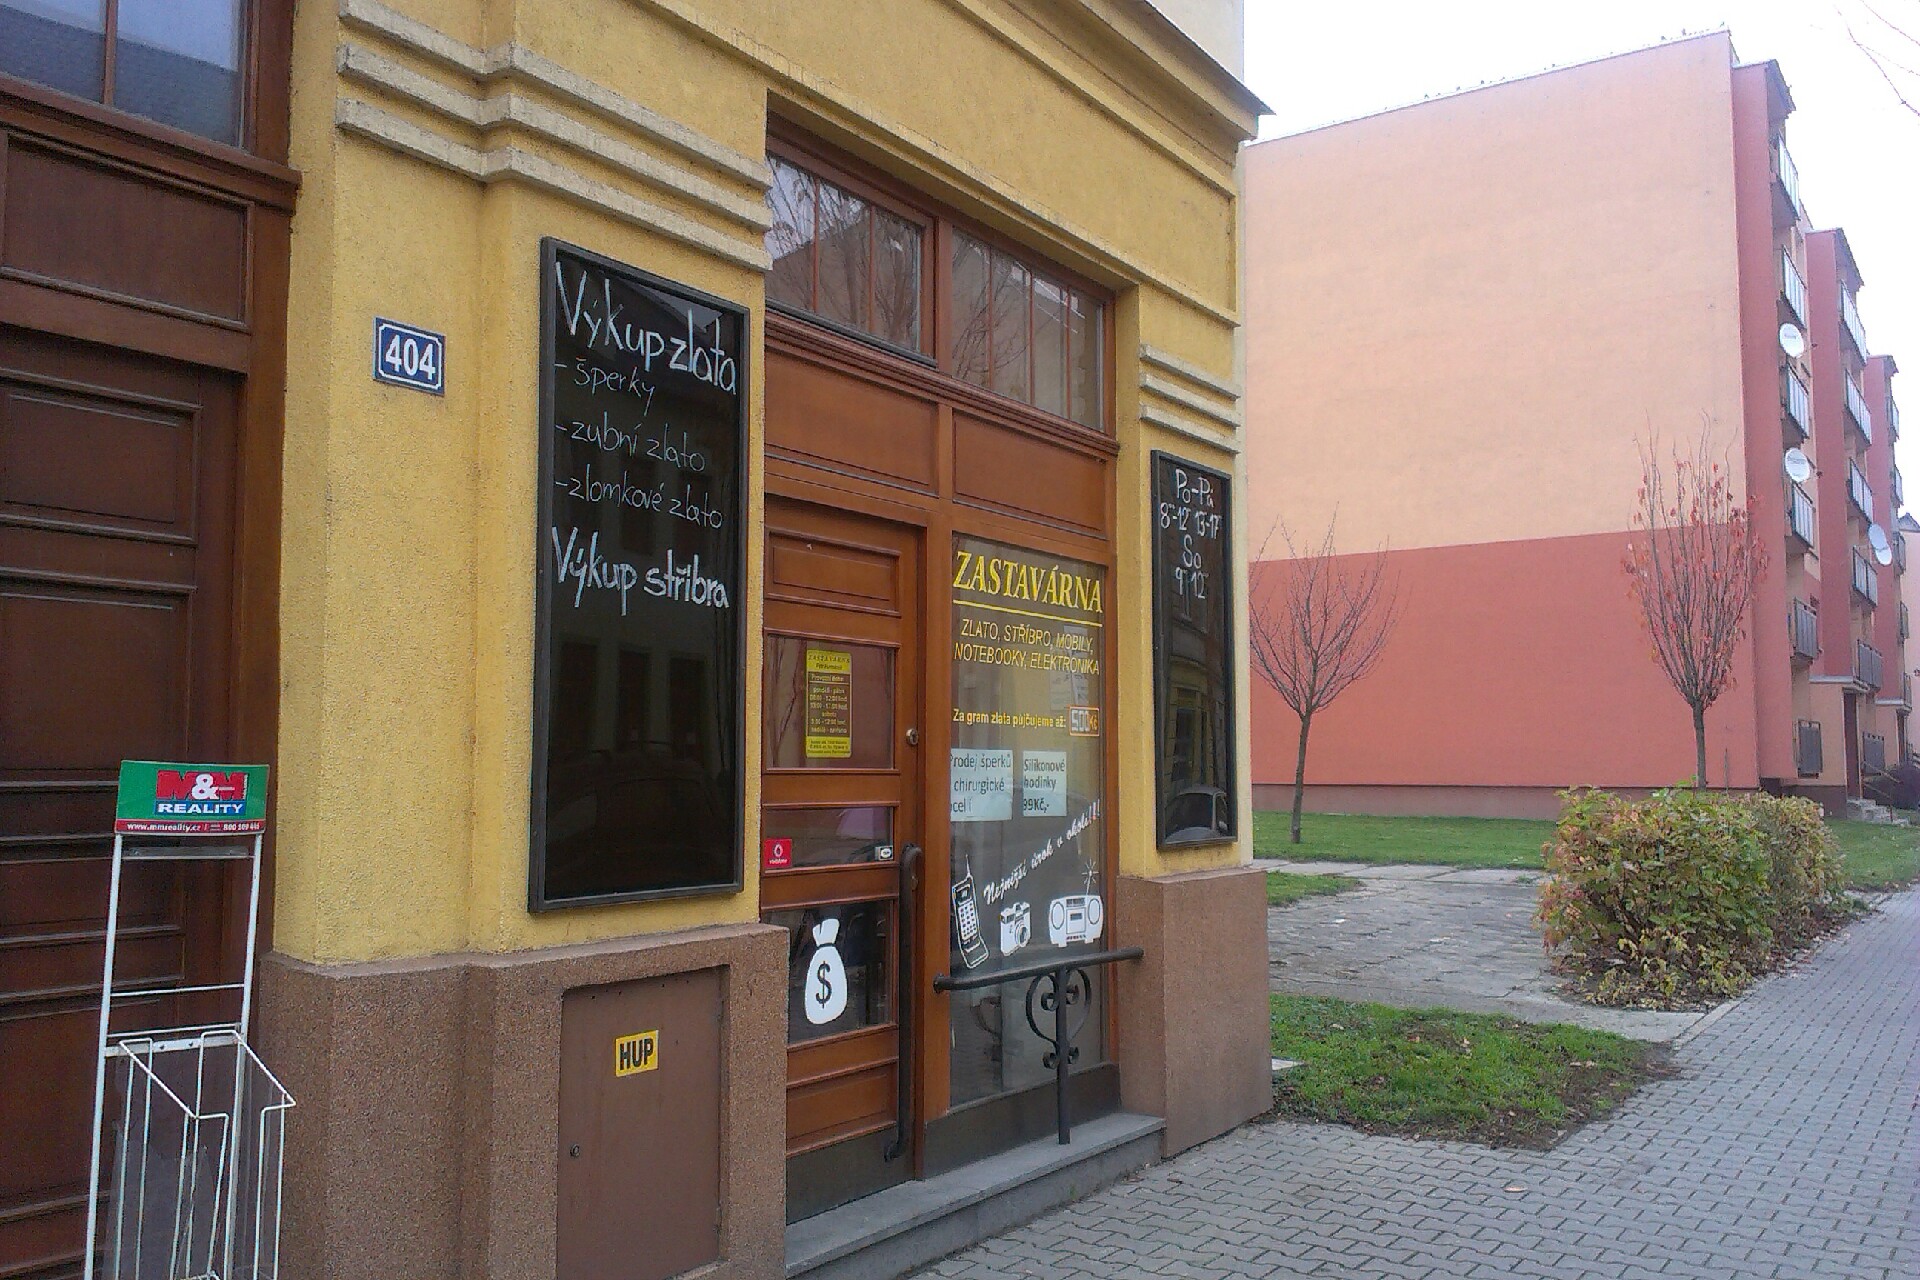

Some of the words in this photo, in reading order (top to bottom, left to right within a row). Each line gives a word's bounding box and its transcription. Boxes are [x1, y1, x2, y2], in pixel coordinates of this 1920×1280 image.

[555, 261, 665, 372] Výkup
[668, 309, 737, 395] zlata
[385, 334, 436, 380] 404
[573, 357, 656, 417] šperky
[646, 422, 706, 472] zlato
[668, 484, 723, 529] zlato
[1182, 534, 1202, 569] So
[551, 526, 639, 617] Výkup
[952, 551, 1104, 614] ZASTAVÁRNA
[960, 618, 1001, 642] ZLATO,
[1003, 623, 1053, 650] STŘÍBRO,
[1056, 632, 1094, 656] MOBILY,
[954, 642, 1028, 670] NOTEBOOKY,
[1030, 652, 1099, 675] ELEKTRONIKA
[953, 708, 965, 722] Za
[966, 712, 989, 725] gram
[991, 711, 1011, 725] zlata
[980, 753, 1012, 771] šperků
[1024, 758, 1066, 772] Silikonové
[156, 770, 246, 800] M&M
[954, 777, 1005, 795] chirurgické
[1024, 776, 1057, 792] hodinky
[158, 803, 244, 814] REALITY
[620, 1038, 654, 1071] HUP
